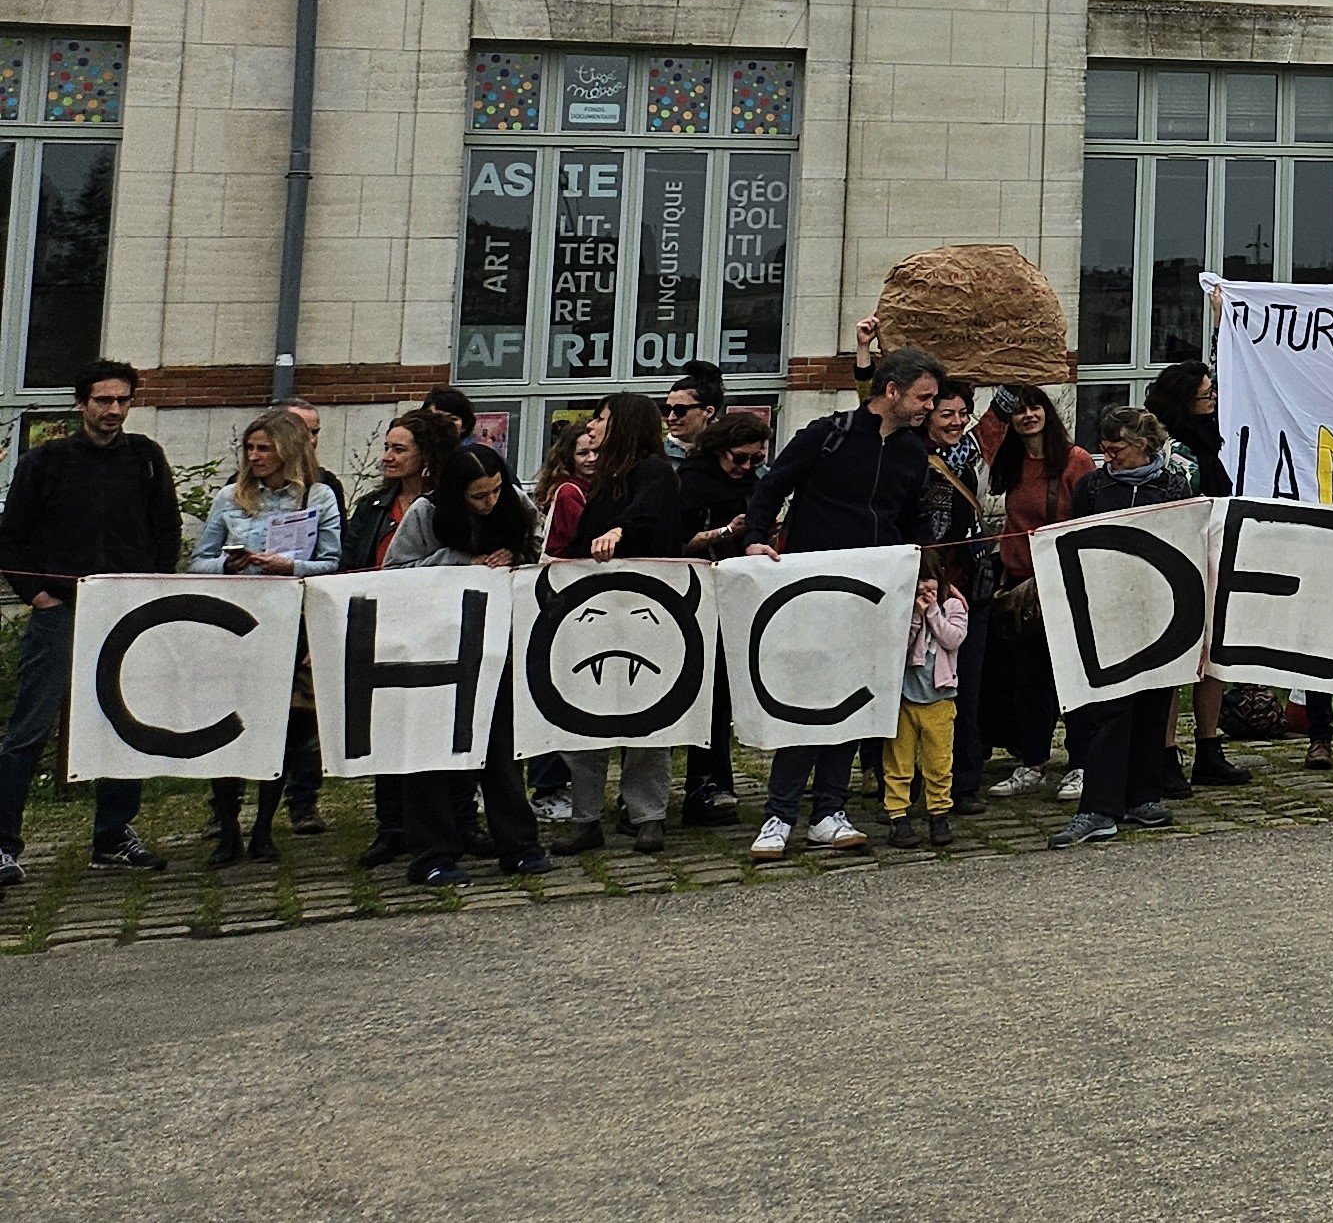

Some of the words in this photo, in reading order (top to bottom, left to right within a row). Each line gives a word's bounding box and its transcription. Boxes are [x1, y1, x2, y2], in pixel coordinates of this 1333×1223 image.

[470, 162, 619, 198] ASIE
[729, 174, 788, 208] GÉO
[559, 214, 612, 238] LIT-
[729, 208, 782, 230] POL
[562, 238, 616, 265] TÉR
[656, 180, 687, 322] LINGUISTIQUE
[728, 234, 762, 257] ITI
[483, 236, 511, 294] ART
[723, 262, 783, 290] QUE
[555, 271, 615, 294] ATU
[554, 299, 592, 322] RE
[461, 329, 749, 369] AFRIQUE
[94, 565, 886, 760] CHOC
